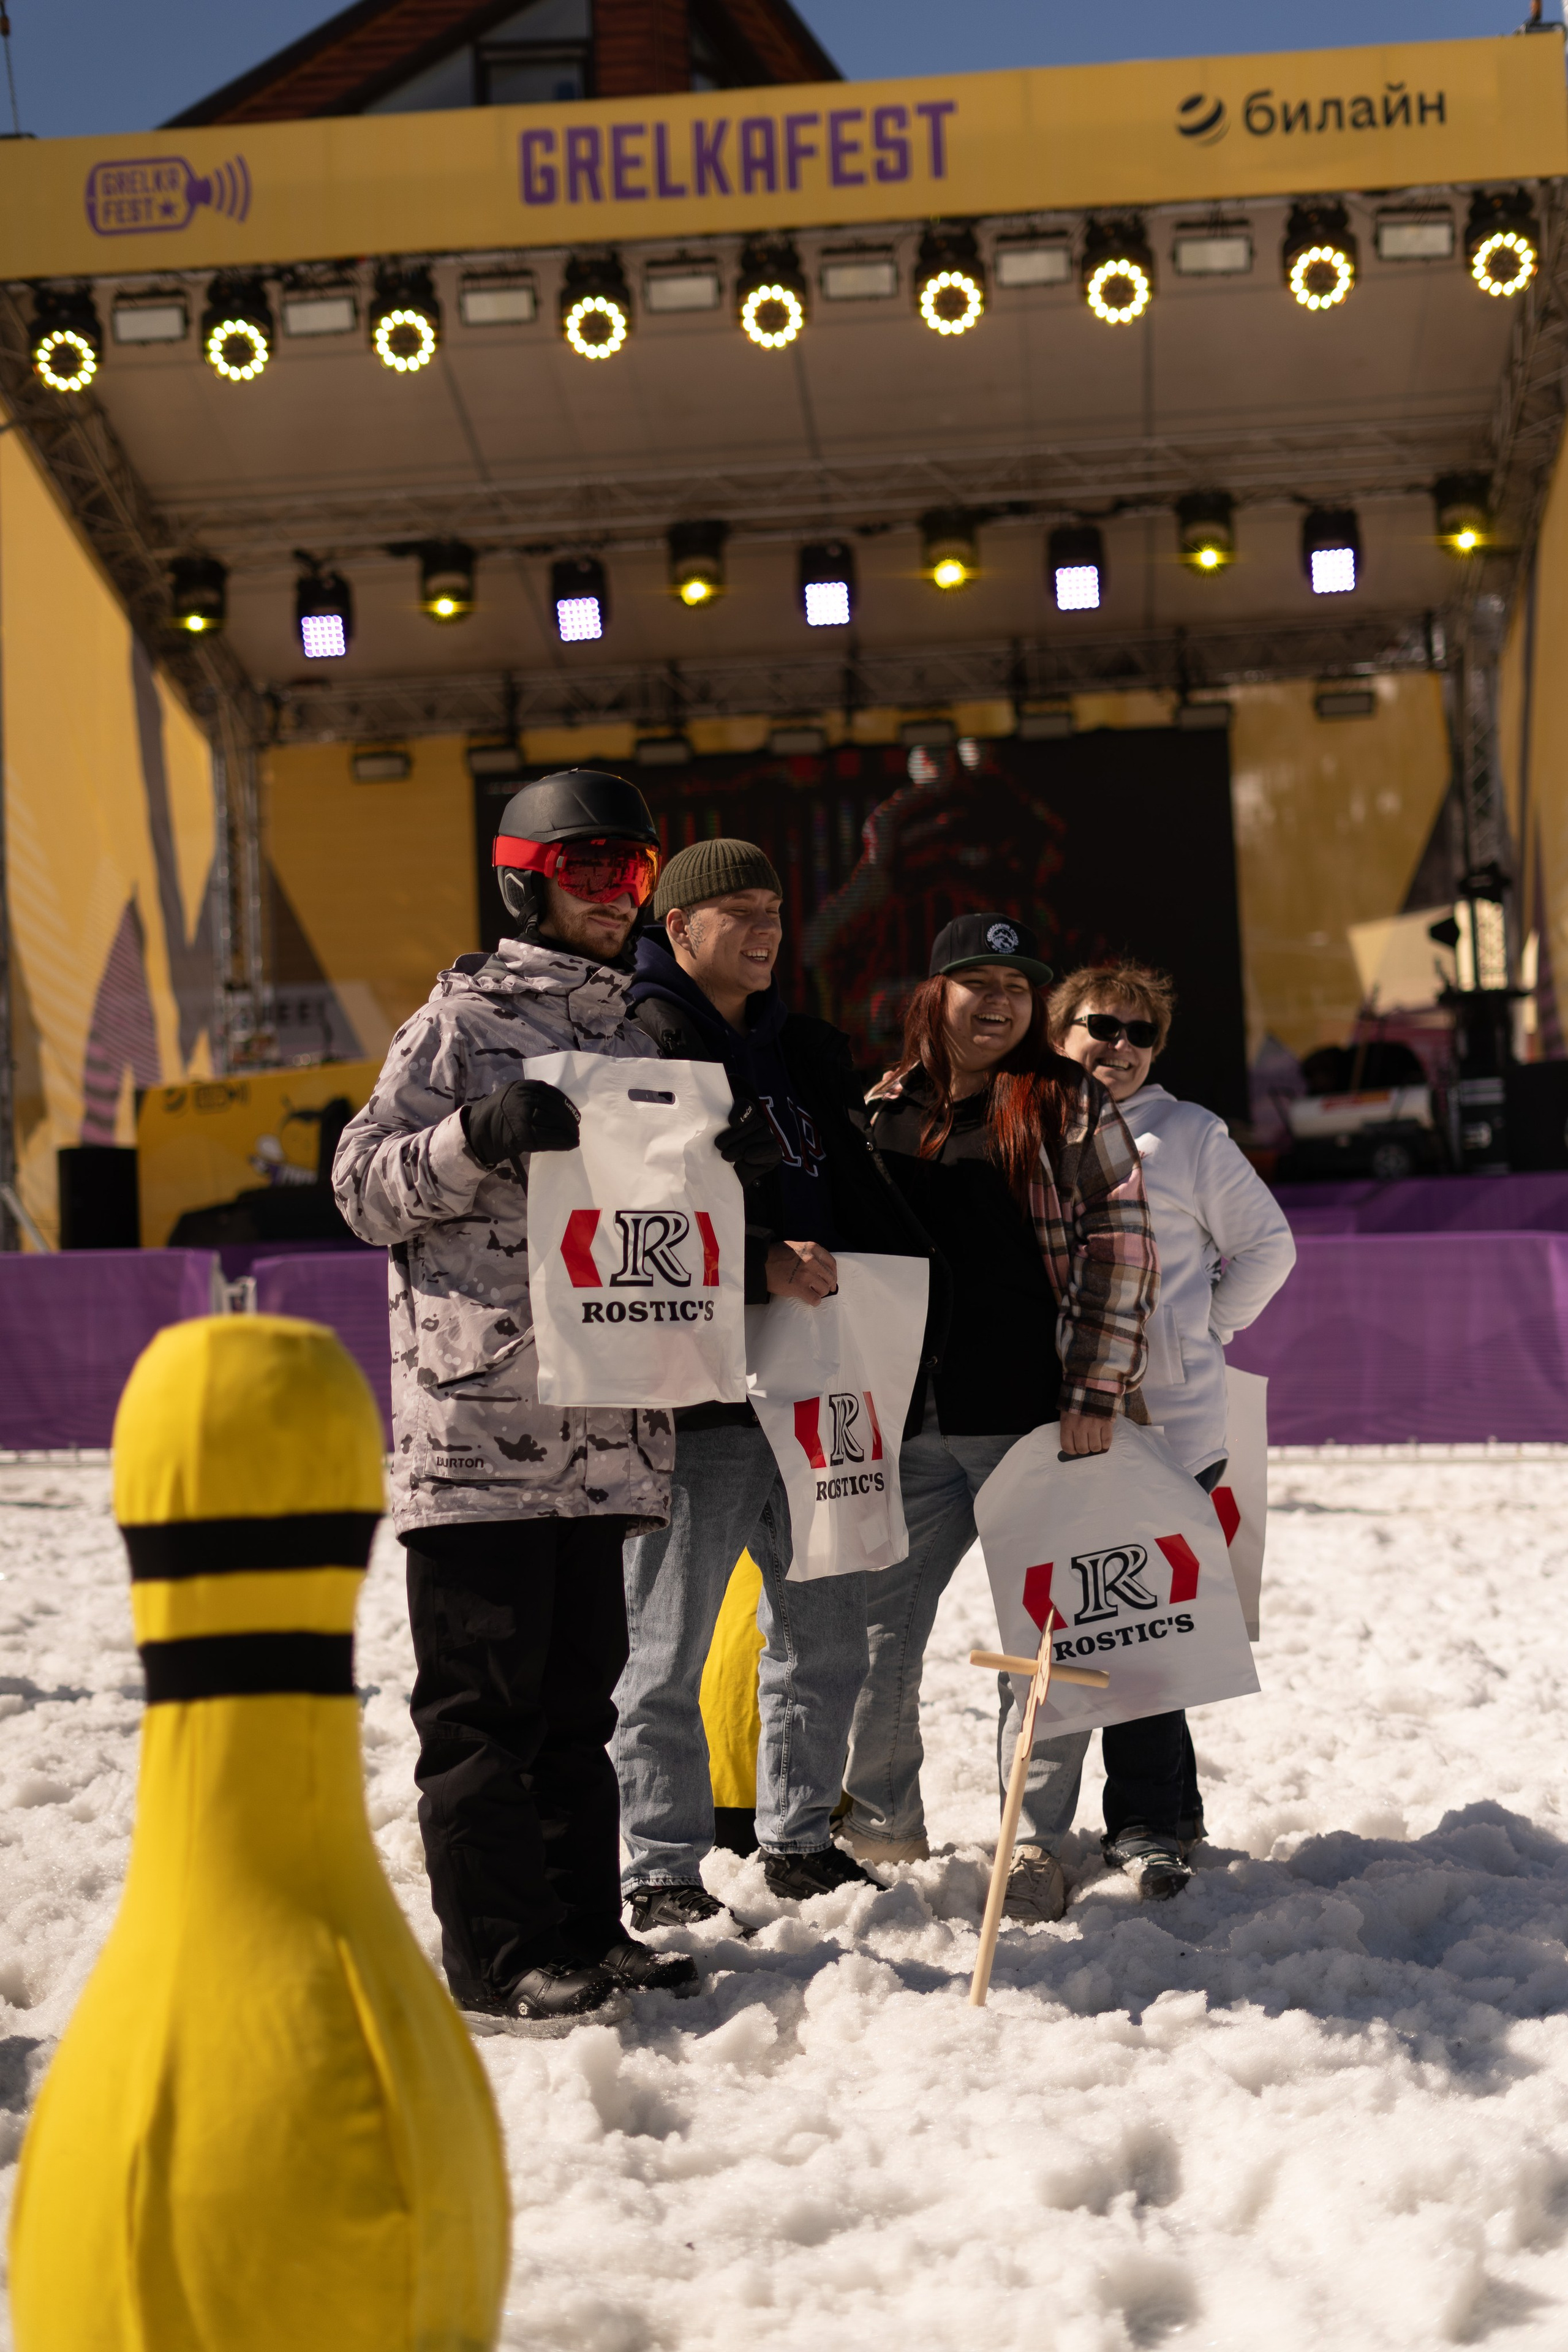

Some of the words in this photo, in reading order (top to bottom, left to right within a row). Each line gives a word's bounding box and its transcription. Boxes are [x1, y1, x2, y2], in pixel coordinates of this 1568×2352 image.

[1243, 81, 1447, 136] билайн
[520, 101, 957, 205] GRELKAFEST
[103, 197, 153, 224] FEST
[582, 1300, 714, 1324] ROSTIC'S
[436, 1456, 484, 1468] BURTON
[816, 1472, 884, 1501] ROSTIC'S
[1053, 1613, 1194, 1661] ROSTIC'S
